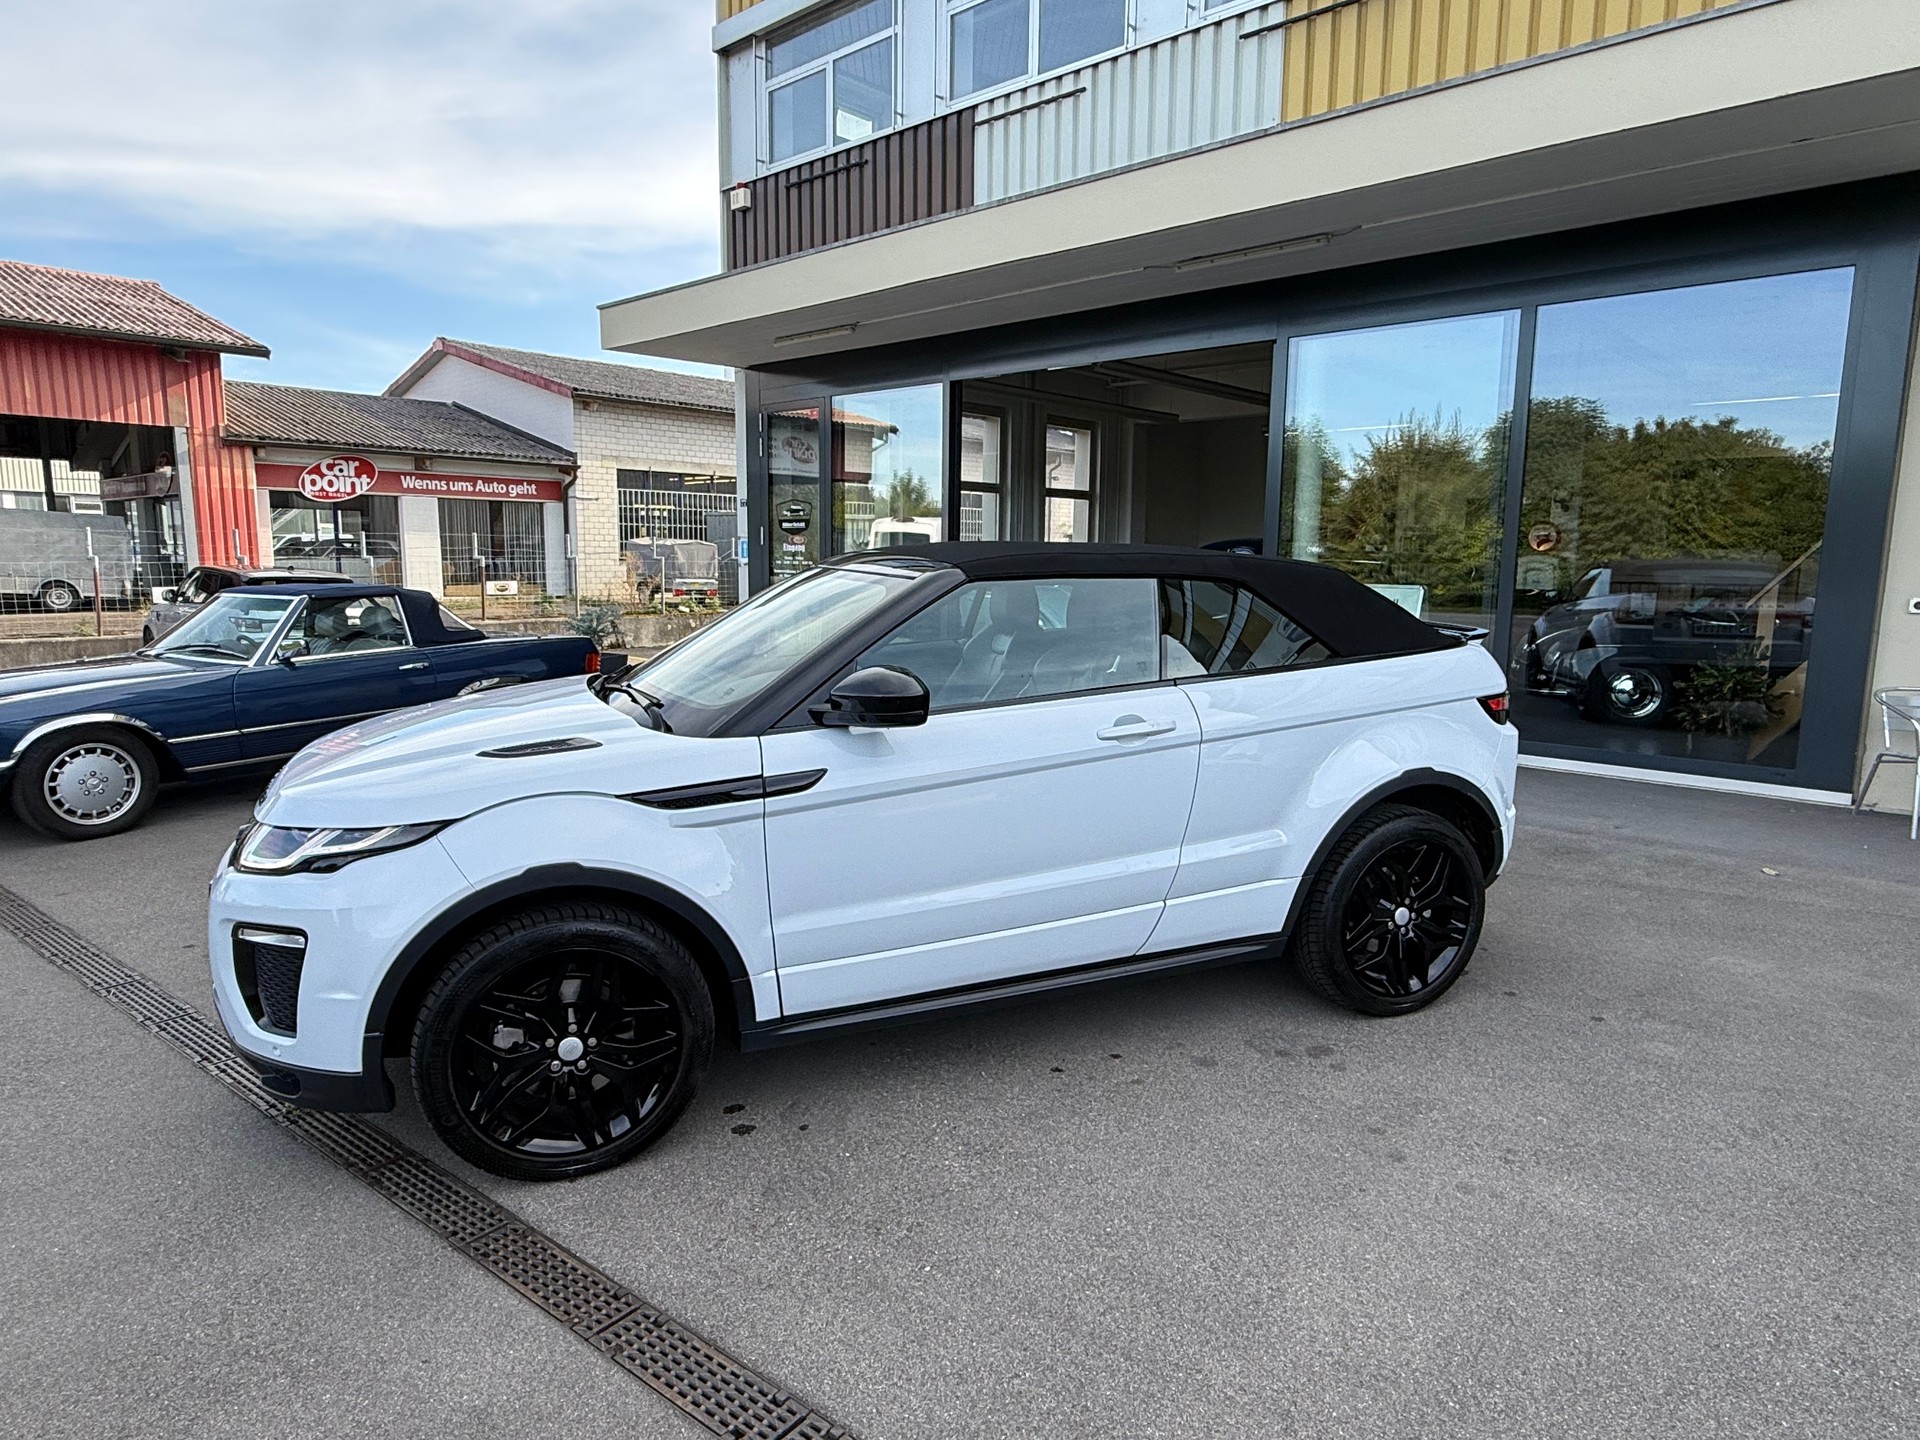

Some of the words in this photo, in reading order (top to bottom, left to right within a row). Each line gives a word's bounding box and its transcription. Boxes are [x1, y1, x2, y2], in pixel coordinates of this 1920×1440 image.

[320, 459, 360, 477] car
[304, 473, 371, 496] point
[400, 475, 447, 491] Wenns
[475, 480, 506, 494] Auto
[508, 482, 537, 497] geht
